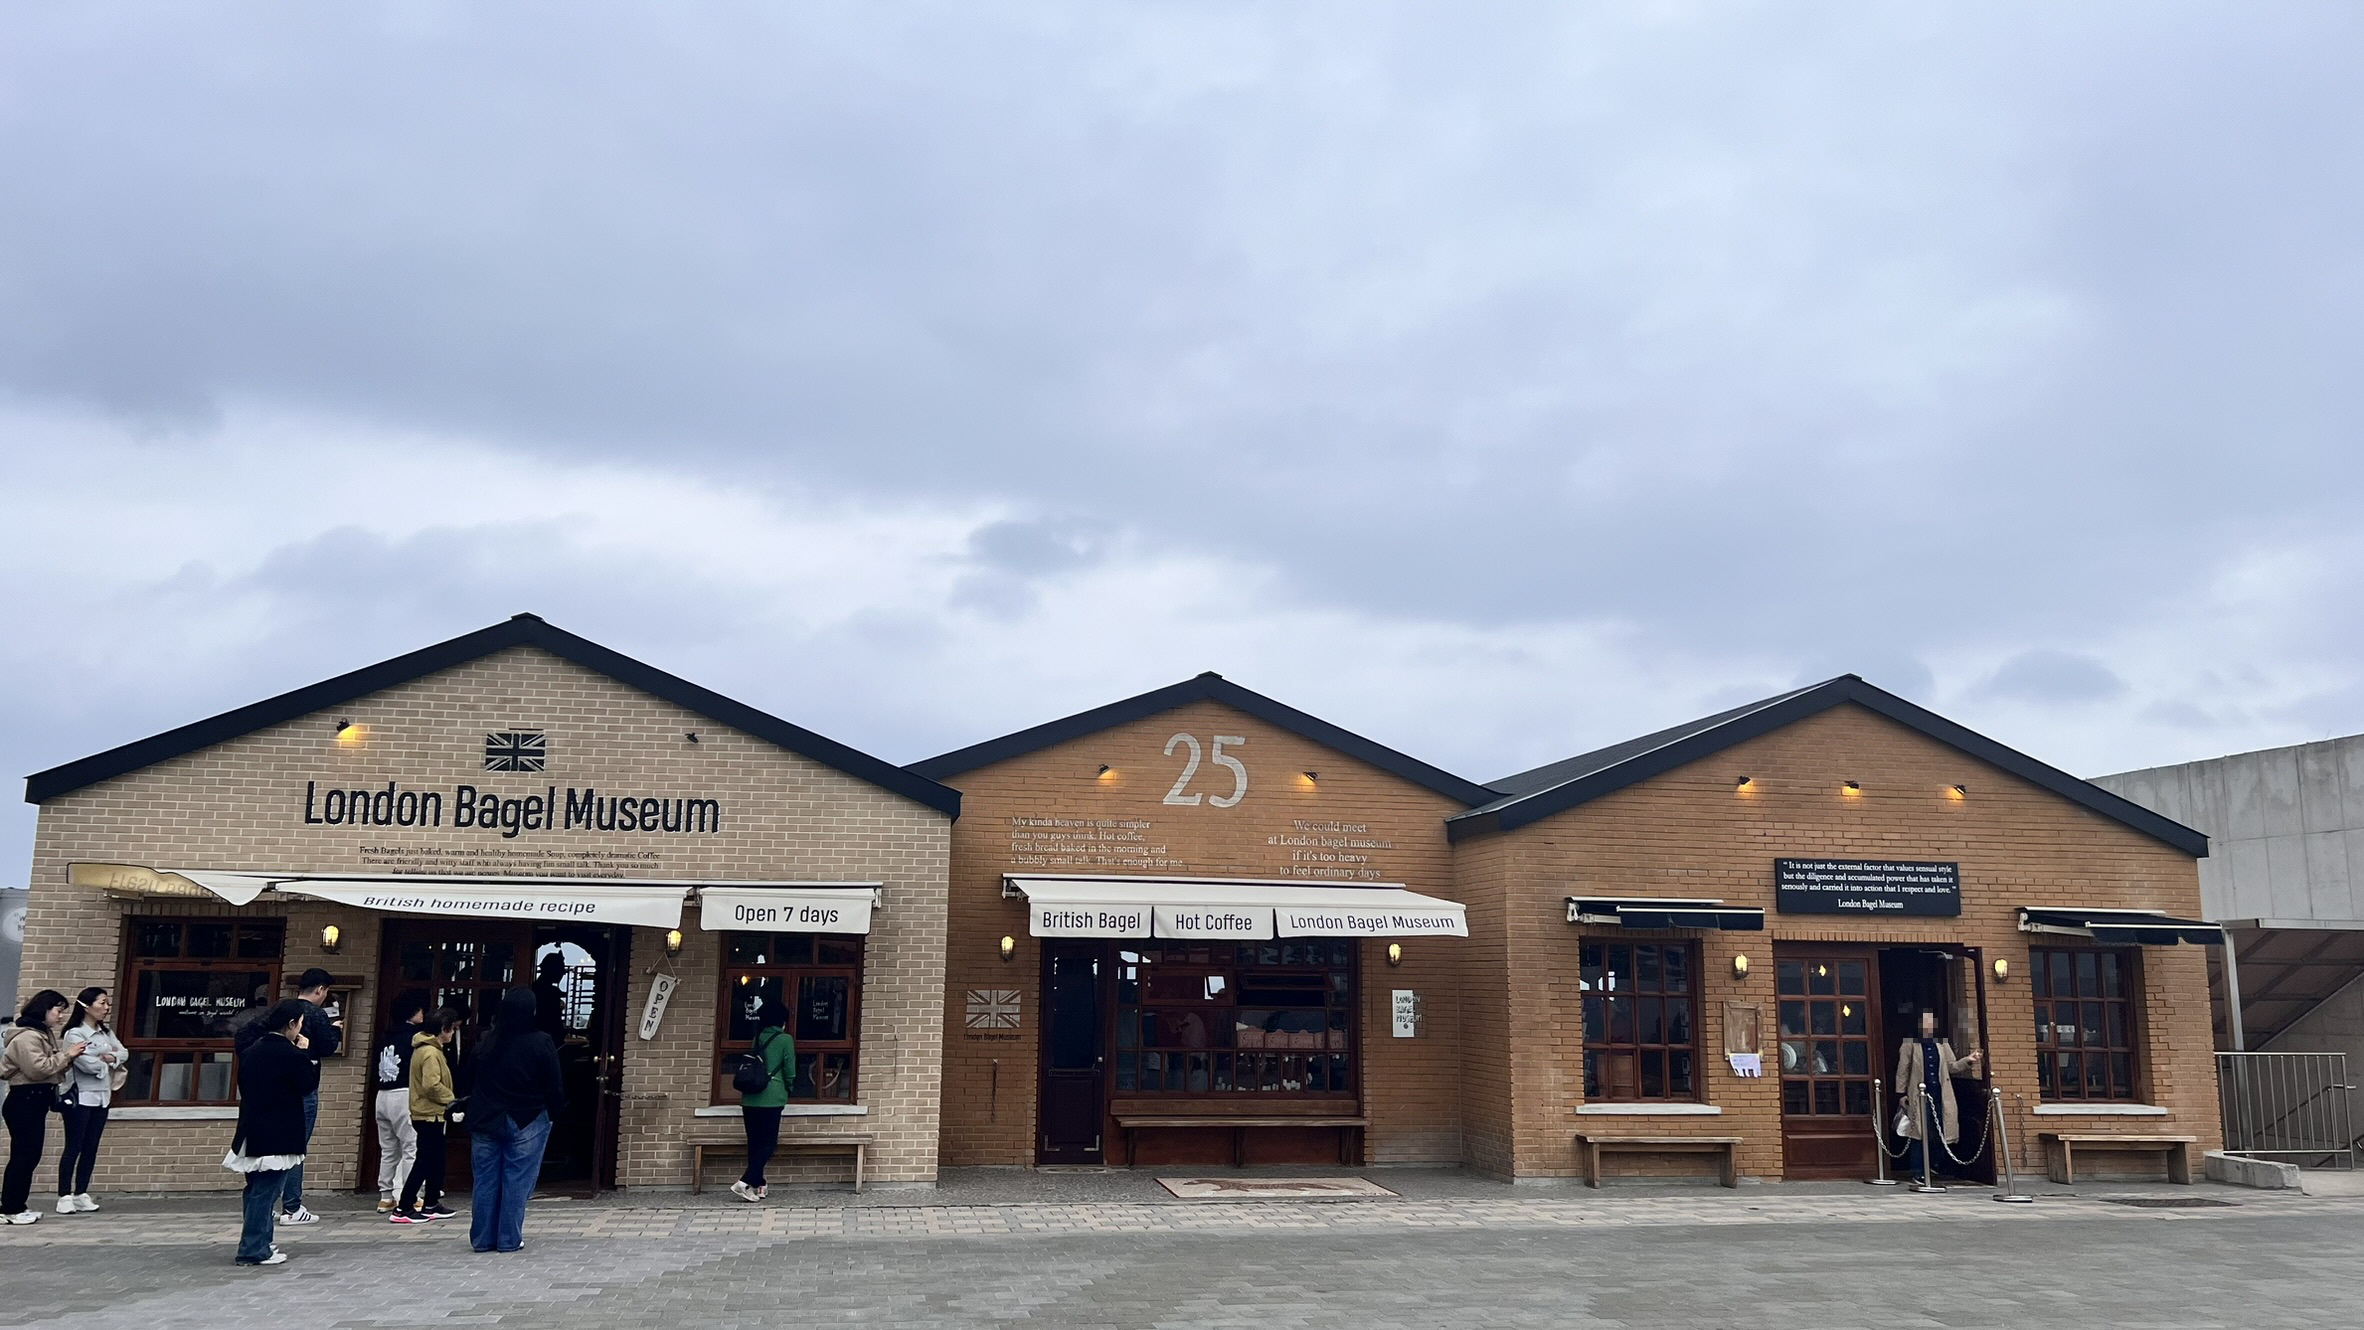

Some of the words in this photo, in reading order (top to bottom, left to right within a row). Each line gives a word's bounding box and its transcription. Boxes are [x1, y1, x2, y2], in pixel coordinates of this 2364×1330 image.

[1163, 732, 1247, 807] 25
[304, 780, 442, 828] London
[454, 784, 556, 839] Bagel
[564, 787, 720, 834] Museum
[1012, 817, 1026, 828] My
[1029, 818, 1053, 827] kinda
[1055, 818, 1084, 828] heaven
[1087, 819, 1094, 827] is
[1096, 819, 1117, 830] quite
[1119, 819, 1151, 830] simpler
[1294, 820, 1310, 831] We
[1312, 821, 1340, 832] could
[1343, 824, 1367, 832] meet
[1012, 830, 1030, 839] than
[1032, 832, 1048, 841] you
[1051, 832, 1070, 841] guys
[1073, 831, 1096, 840] think.
[1100, 831, 1115, 840] Hot
[1117, 831, 1146, 842] coffee,
[1268, 836, 1277, 845] at
[1280, 835, 1319, 846] London
[1321, 836, 1348, 849] bagel
[1350, 839, 1392, 848] museum
[360, 846, 379, 854] Fresh
[381, 847, 404, 856] Bagels
[406, 848, 419, 856] just
[420, 848, 442, 856] baked,
[480, 850, 506, 858] healthy
[507, 850, 545, 858] homemade
[547, 851, 566, 860] Soup,
[568, 852, 605, 860] completely
[1012, 842, 1033, 851] fresh
[1035, 843, 1059, 852] bread
[1061, 844, 1086, 852] baked
[1088, 844, 1096, 852] in
[1099, 844, 1112, 853] the
[1114, 845, 1149, 856] morning
[1151, 845, 1166, 854] and
[362, 857, 382, 865] There
[396, 858, 423, 866] friendly
[440, 859, 457, 868] witty
[492, 860, 517, 869] always
[518, 861, 542, 869] having
[1019, 856, 1047, 866] bubbly
[1050, 856, 1073, 865] small
[1075, 856, 1093, 865] talk.
[1096, 856, 1120, 866] That's
[1123, 858, 1153, 868] enough
[1155, 857, 1168, 866] for
[1170, 859, 1186, 867] me.
[1292, 850, 1302, 861] if
[1303, 851, 1317, 861] it's
[1320, 852, 1336, 862] too
[1338, 852, 1368, 865] heavy
[1280, 866, 1290, 876] to
[1293, 866, 1311, 876] feel
[1314, 866, 1355, 880] ordinary
[1358, 867, 1381, 880] days
[1789, 862, 1795, 870] It
[1796, 862, 1801, 870] is
[1814, 862, 1826, 871] just
[1838, 863, 1862, 871] external
[1864, 864, 1882, 872] factor
[1883, 864, 1895, 872] that
[1896, 864, 1914, 872] values
[1916, 864, 1937, 872] sensual
[1938, 866, 1952, 875] style
[1783, 872, 1795, 880] but
[1796, 872, 1806, 880] the
[1807, 872, 1834, 882] diligence
[1834, 873, 1846, 881] and
[1848, 874, 1885, 882] accumulated
[1886, 875, 1905, 884] power
[1920, 875, 1930, 883] has
[1931, 875, 1948, 883] taken
[1949, 876, 1954, 884] it
[1809, 883, 1821, 891] and
[1822, 883, 1844, 892] carried
[1844, 884, 1850, 892] it
[1850, 884, 1863, 892] into
[1864, 884, 1883, 892] action
[1884, 884, 1896, 892] that
[1897, 884, 1901, 892] I
[1902, 886, 1923, 895] respect
[1924, 886, 1936, 894] and
[1937, 886, 1951, 894] love.
[363, 896, 425, 910] British
[430, 898, 534, 913] homemade
[540, 900, 597, 916] recipe
[1838, 899, 1861, 908] London
[1862, 900, 1878, 911] Bagel
[1879, 900, 1904, 909] Museum
[735, 904, 776, 924] Open
[783, 906, 794, 922] 7
[800, 906, 838, 926] days
[1043, 911, 1093, 929] British
[1099, 912, 1141, 932] Bagel
[1176, 914, 1201, 930] Hot
[1205, 914, 1252, 931] Coffee
[1290, 915, 1343, 930] London
[1348, 916, 1388, 932] Bagel
[1392, 916, 1455, 929] Museum
[156, 995, 187, 1007] LONDON
[190, 997, 212, 1008] BAGEL
[216, 997, 246, 1008] MUSEUM
[644, 981, 669, 1032] OPEN
